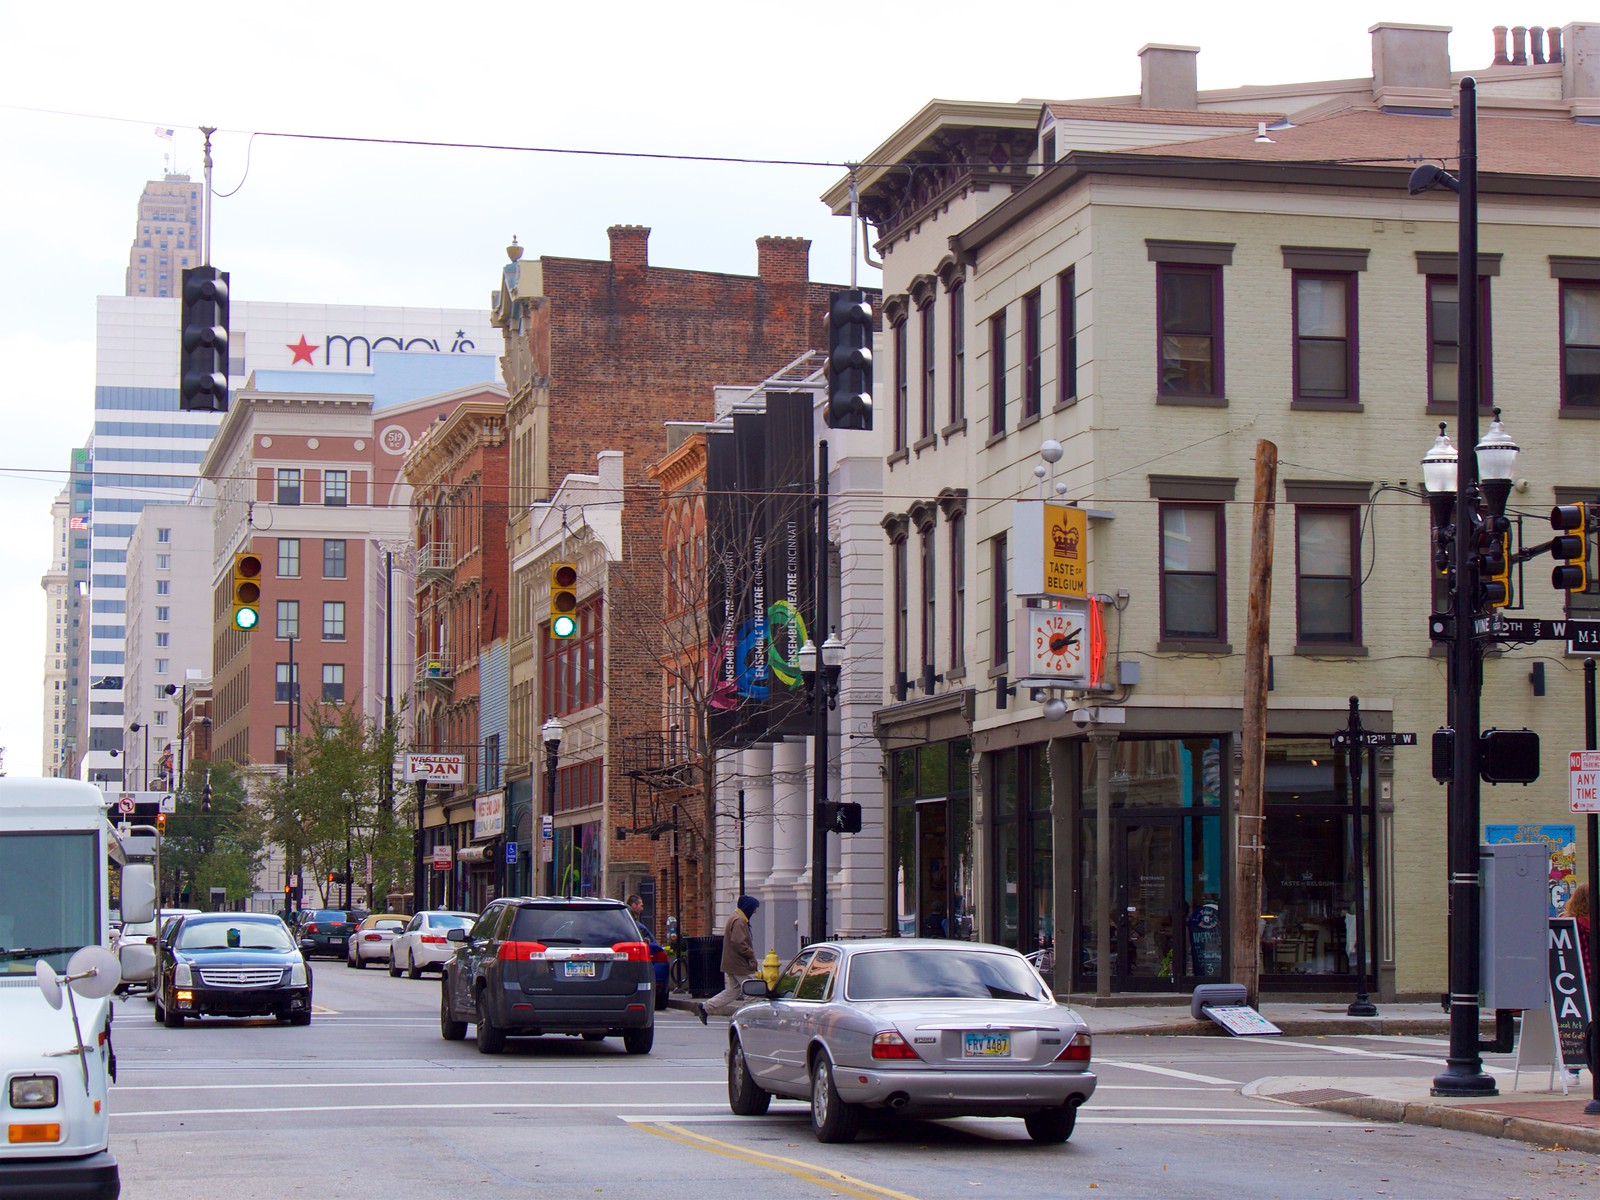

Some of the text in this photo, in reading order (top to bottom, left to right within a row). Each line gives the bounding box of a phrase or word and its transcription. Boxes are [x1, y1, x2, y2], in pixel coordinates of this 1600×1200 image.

[388, 432, 403, 442] 519
[1049, 561, 1075, 576] TASTE
[1047, 576, 1084, 592] BELGIUM
[787, 521, 798, 667] ENSEMBLE THEATRE CINCINNATI
[754, 536, 765, 678] ENSEMBLE THEATRE CINCINNATI
[1053, 616, 1063, 630] 12
[1474, 617, 1490, 634] VINE
[1552, 622, 1567, 637] W
[1036, 637, 1044, 650] 9
[1074, 639, 1081, 652] 3
[1055, 659, 1062, 672] 6
[1366, 734, 1386, 744] 12TH
[1403, 734, 1412, 744] W
[1570, 756, 1581, 768] NO
[1577, 774, 1596, 785] ANY
[1576, 788, 1597, 800] TIME
[1280, 880, 1301, 888] TASTE
[1306, 880, 1336, 888] BELGIUM
[967, 1038, 1007, 1051] FRV 4487
